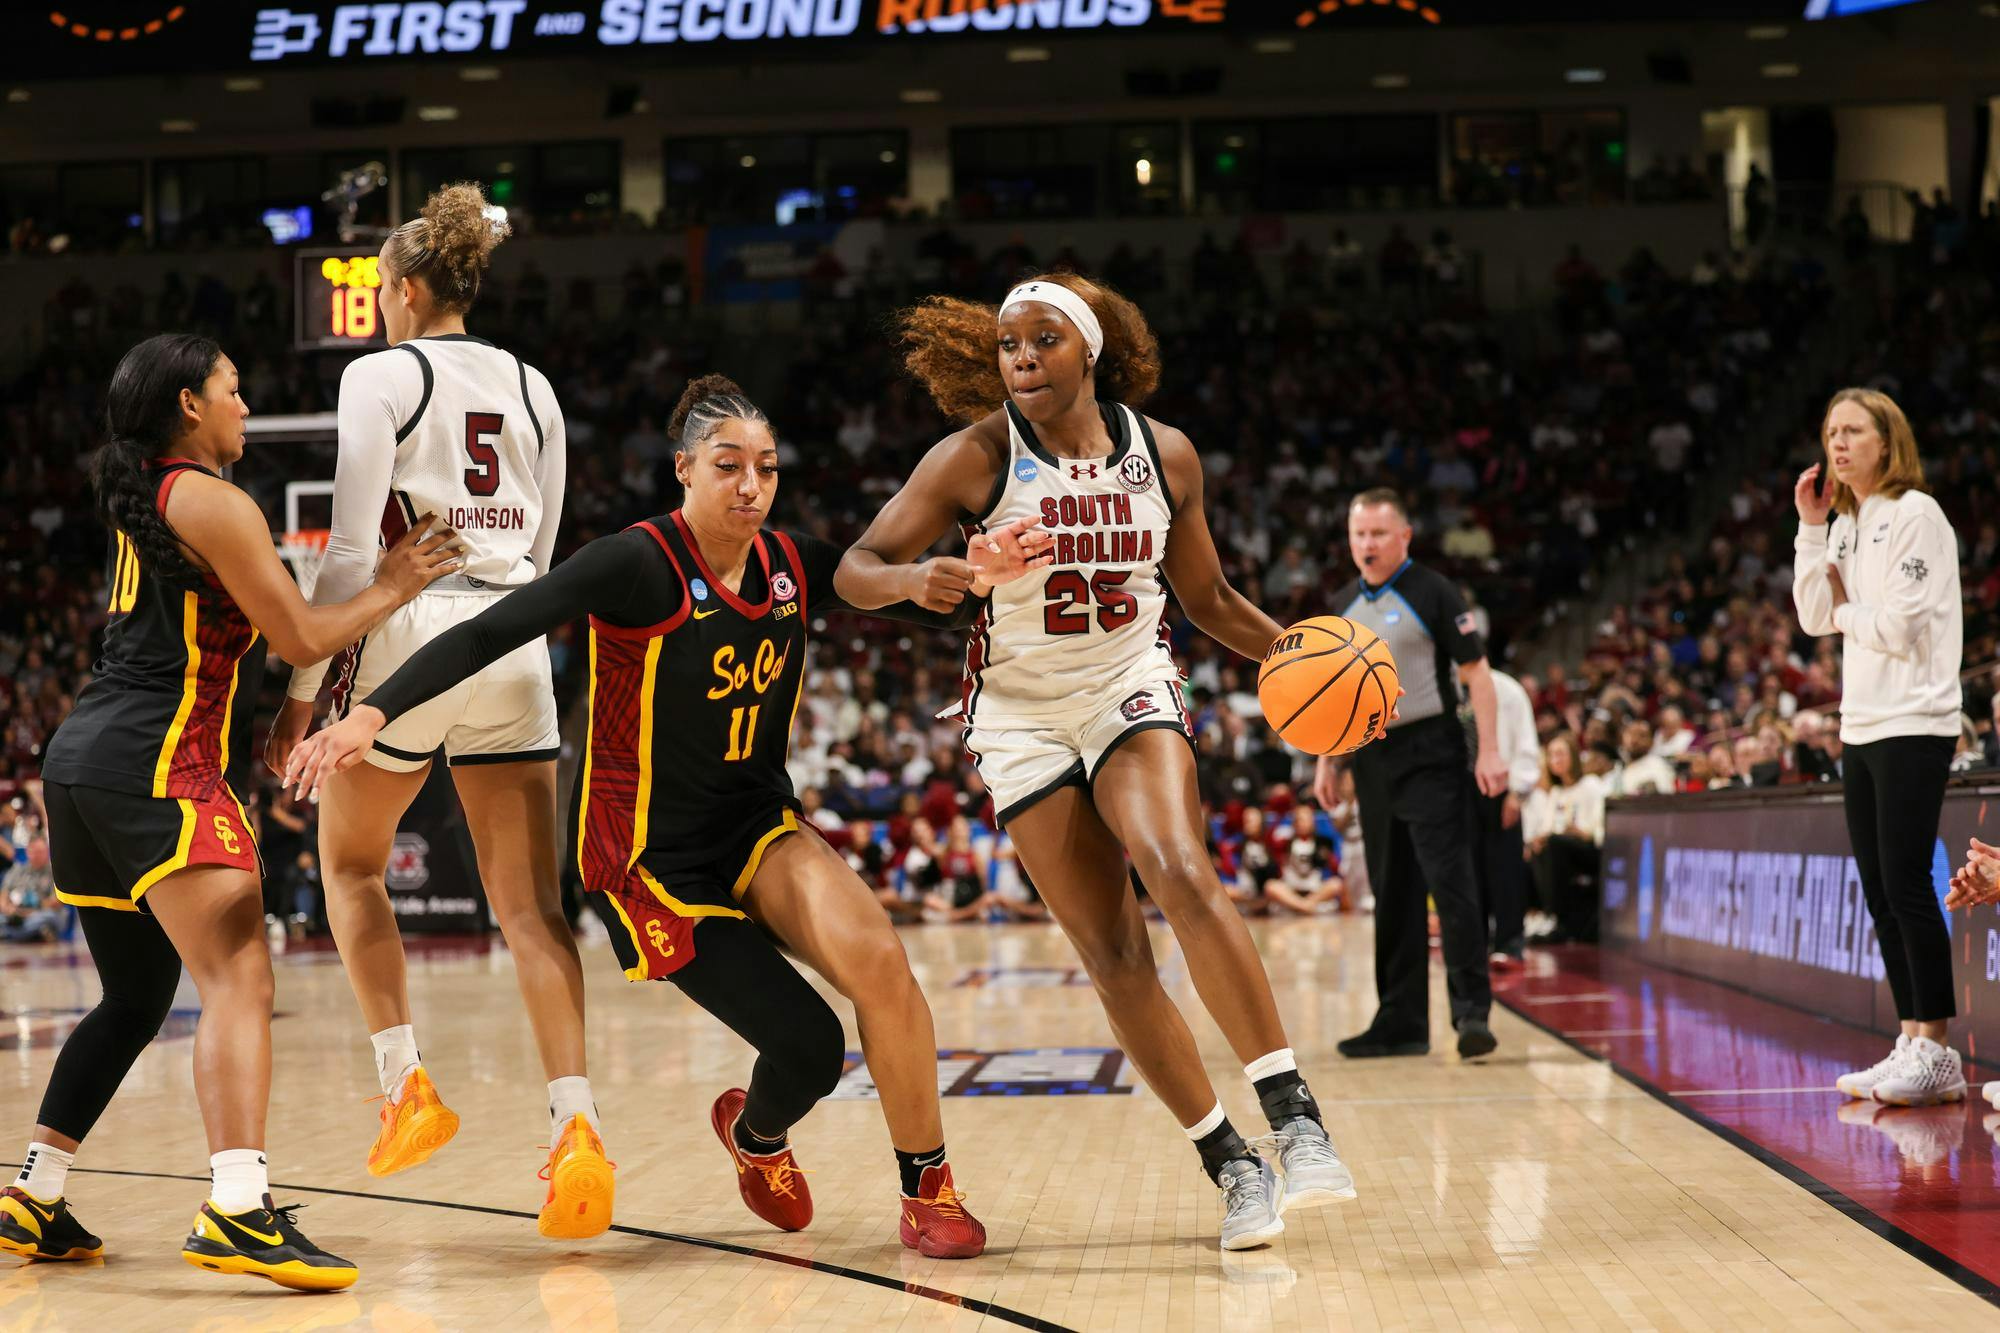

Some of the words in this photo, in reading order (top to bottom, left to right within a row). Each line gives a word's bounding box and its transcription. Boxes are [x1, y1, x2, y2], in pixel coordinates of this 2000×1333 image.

[328, 0, 528, 57] FIRST
[534, 12, 586, 37] AND
[597, 0, 862, 45] SECOND
[332, 287, 377, 338] 18
[464, 411, 504, 497] 5
[1124, 456, 1149, 483] SEC
[444, 507, 525, 530] JOHNSON
[1040, 493, 1133, 528] SOUTH
[107, 528, 141, 614] 10
[1034, 530, 1153, 565] AROLINA
[1044, 569, 1139, 635] 25
[707, 645, 750, 700] So
[724, 704, 760, 761] 11
[213, 815, 241, 854] SC
[645, 919, 675, 958] SC
